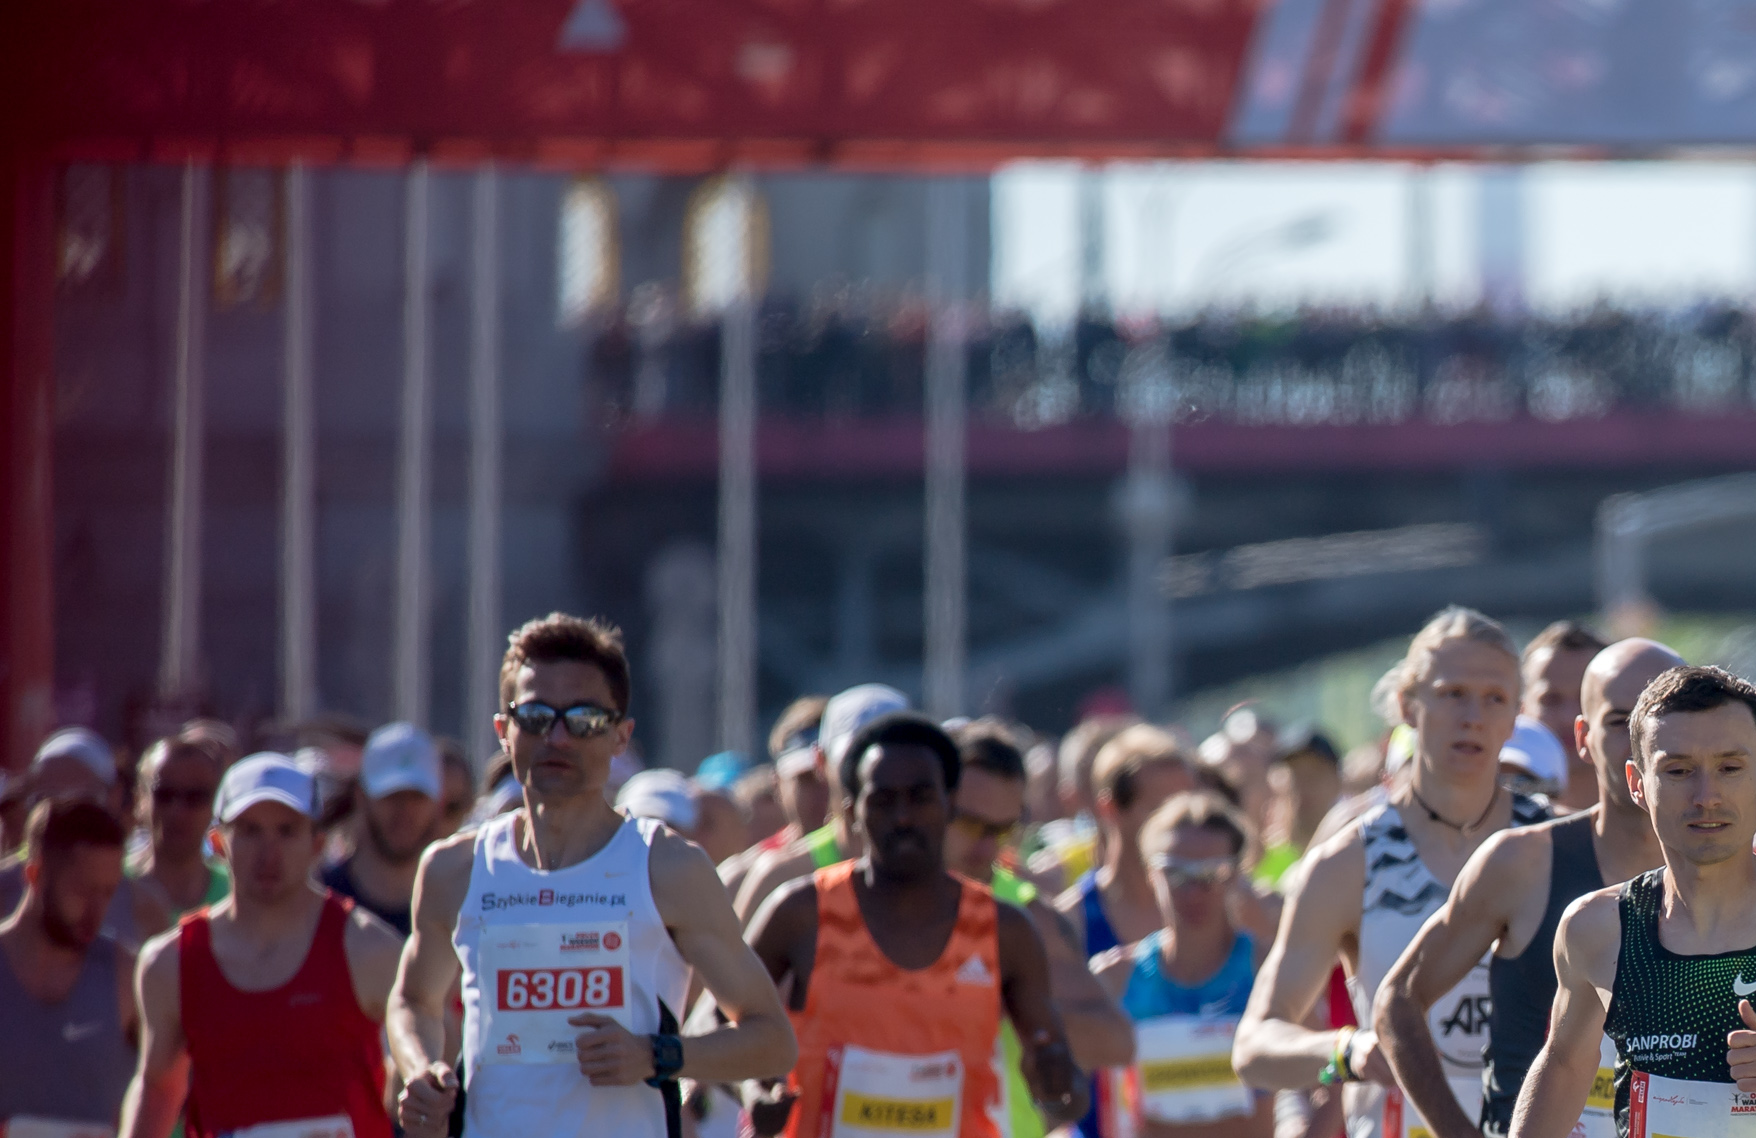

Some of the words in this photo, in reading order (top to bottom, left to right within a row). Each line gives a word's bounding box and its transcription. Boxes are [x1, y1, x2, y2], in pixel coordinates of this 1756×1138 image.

[506, 968, 611, 1009] 6308
[1626, 1034, 1697, 1053] SANPROBI
[1655, 1053, 1673, 1062] Sport
